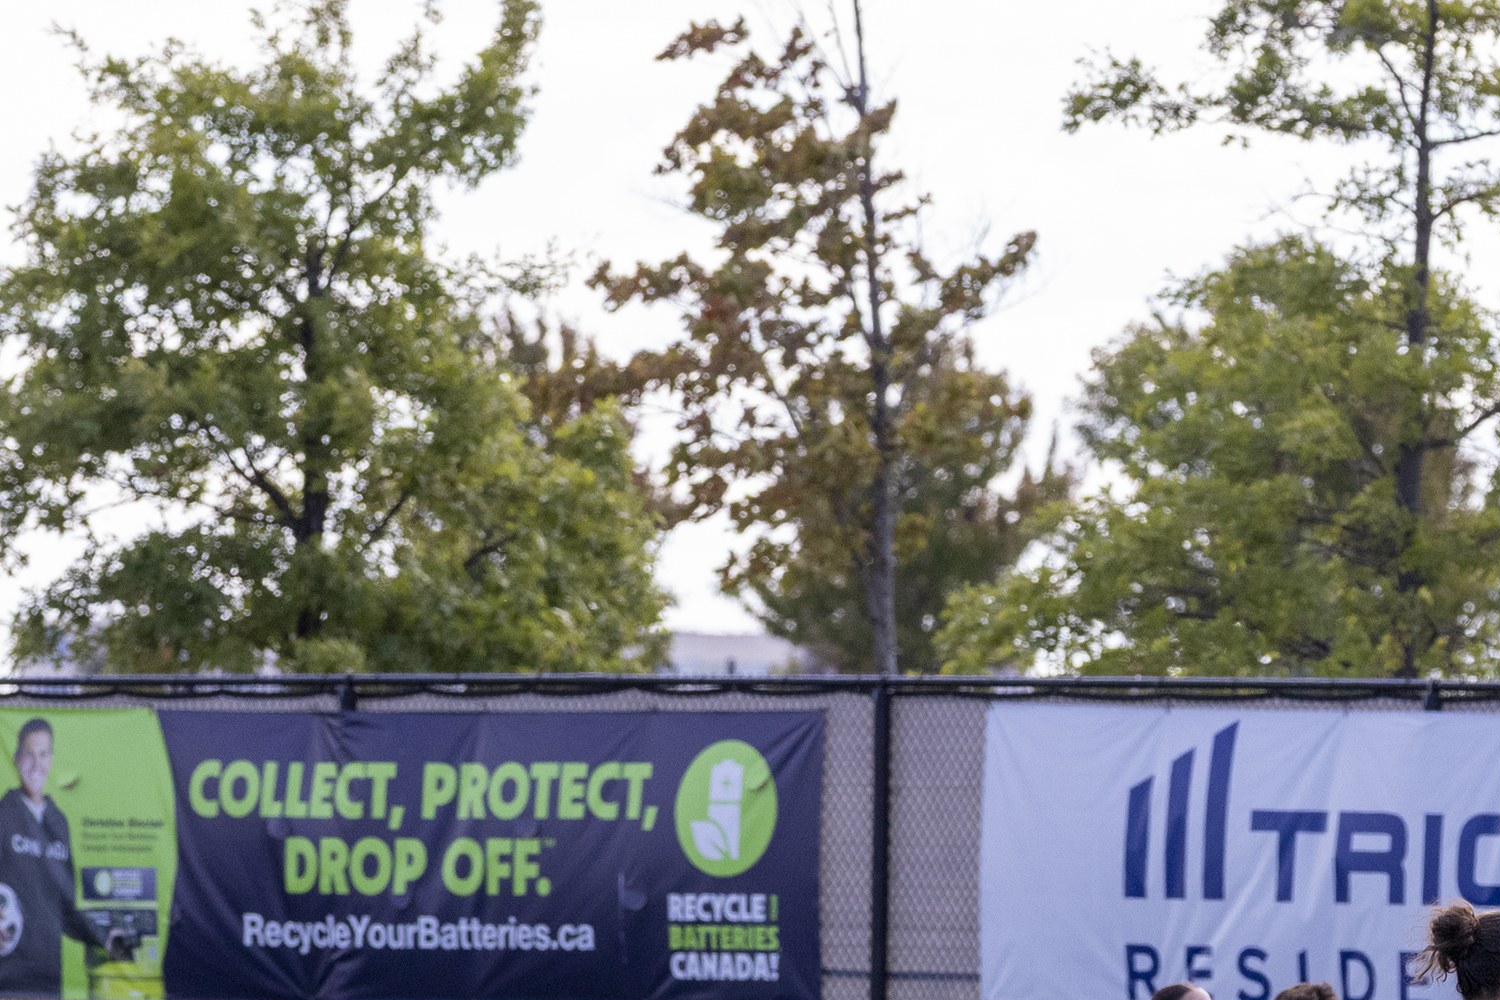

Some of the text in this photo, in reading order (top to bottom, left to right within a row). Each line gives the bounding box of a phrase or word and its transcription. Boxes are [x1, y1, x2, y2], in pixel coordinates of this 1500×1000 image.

[189, 759, 659, 831] COLLECT, PROTECT,
[284, 836, 428, 895] DROP
[667, 893, 767, 922] RECYCLE
[243, 912, 595, 954] RecycleYourBatteries.ca
[668, 924, 780, 950] BATTERIES
[670, 952, 780, 981] CANADA!
